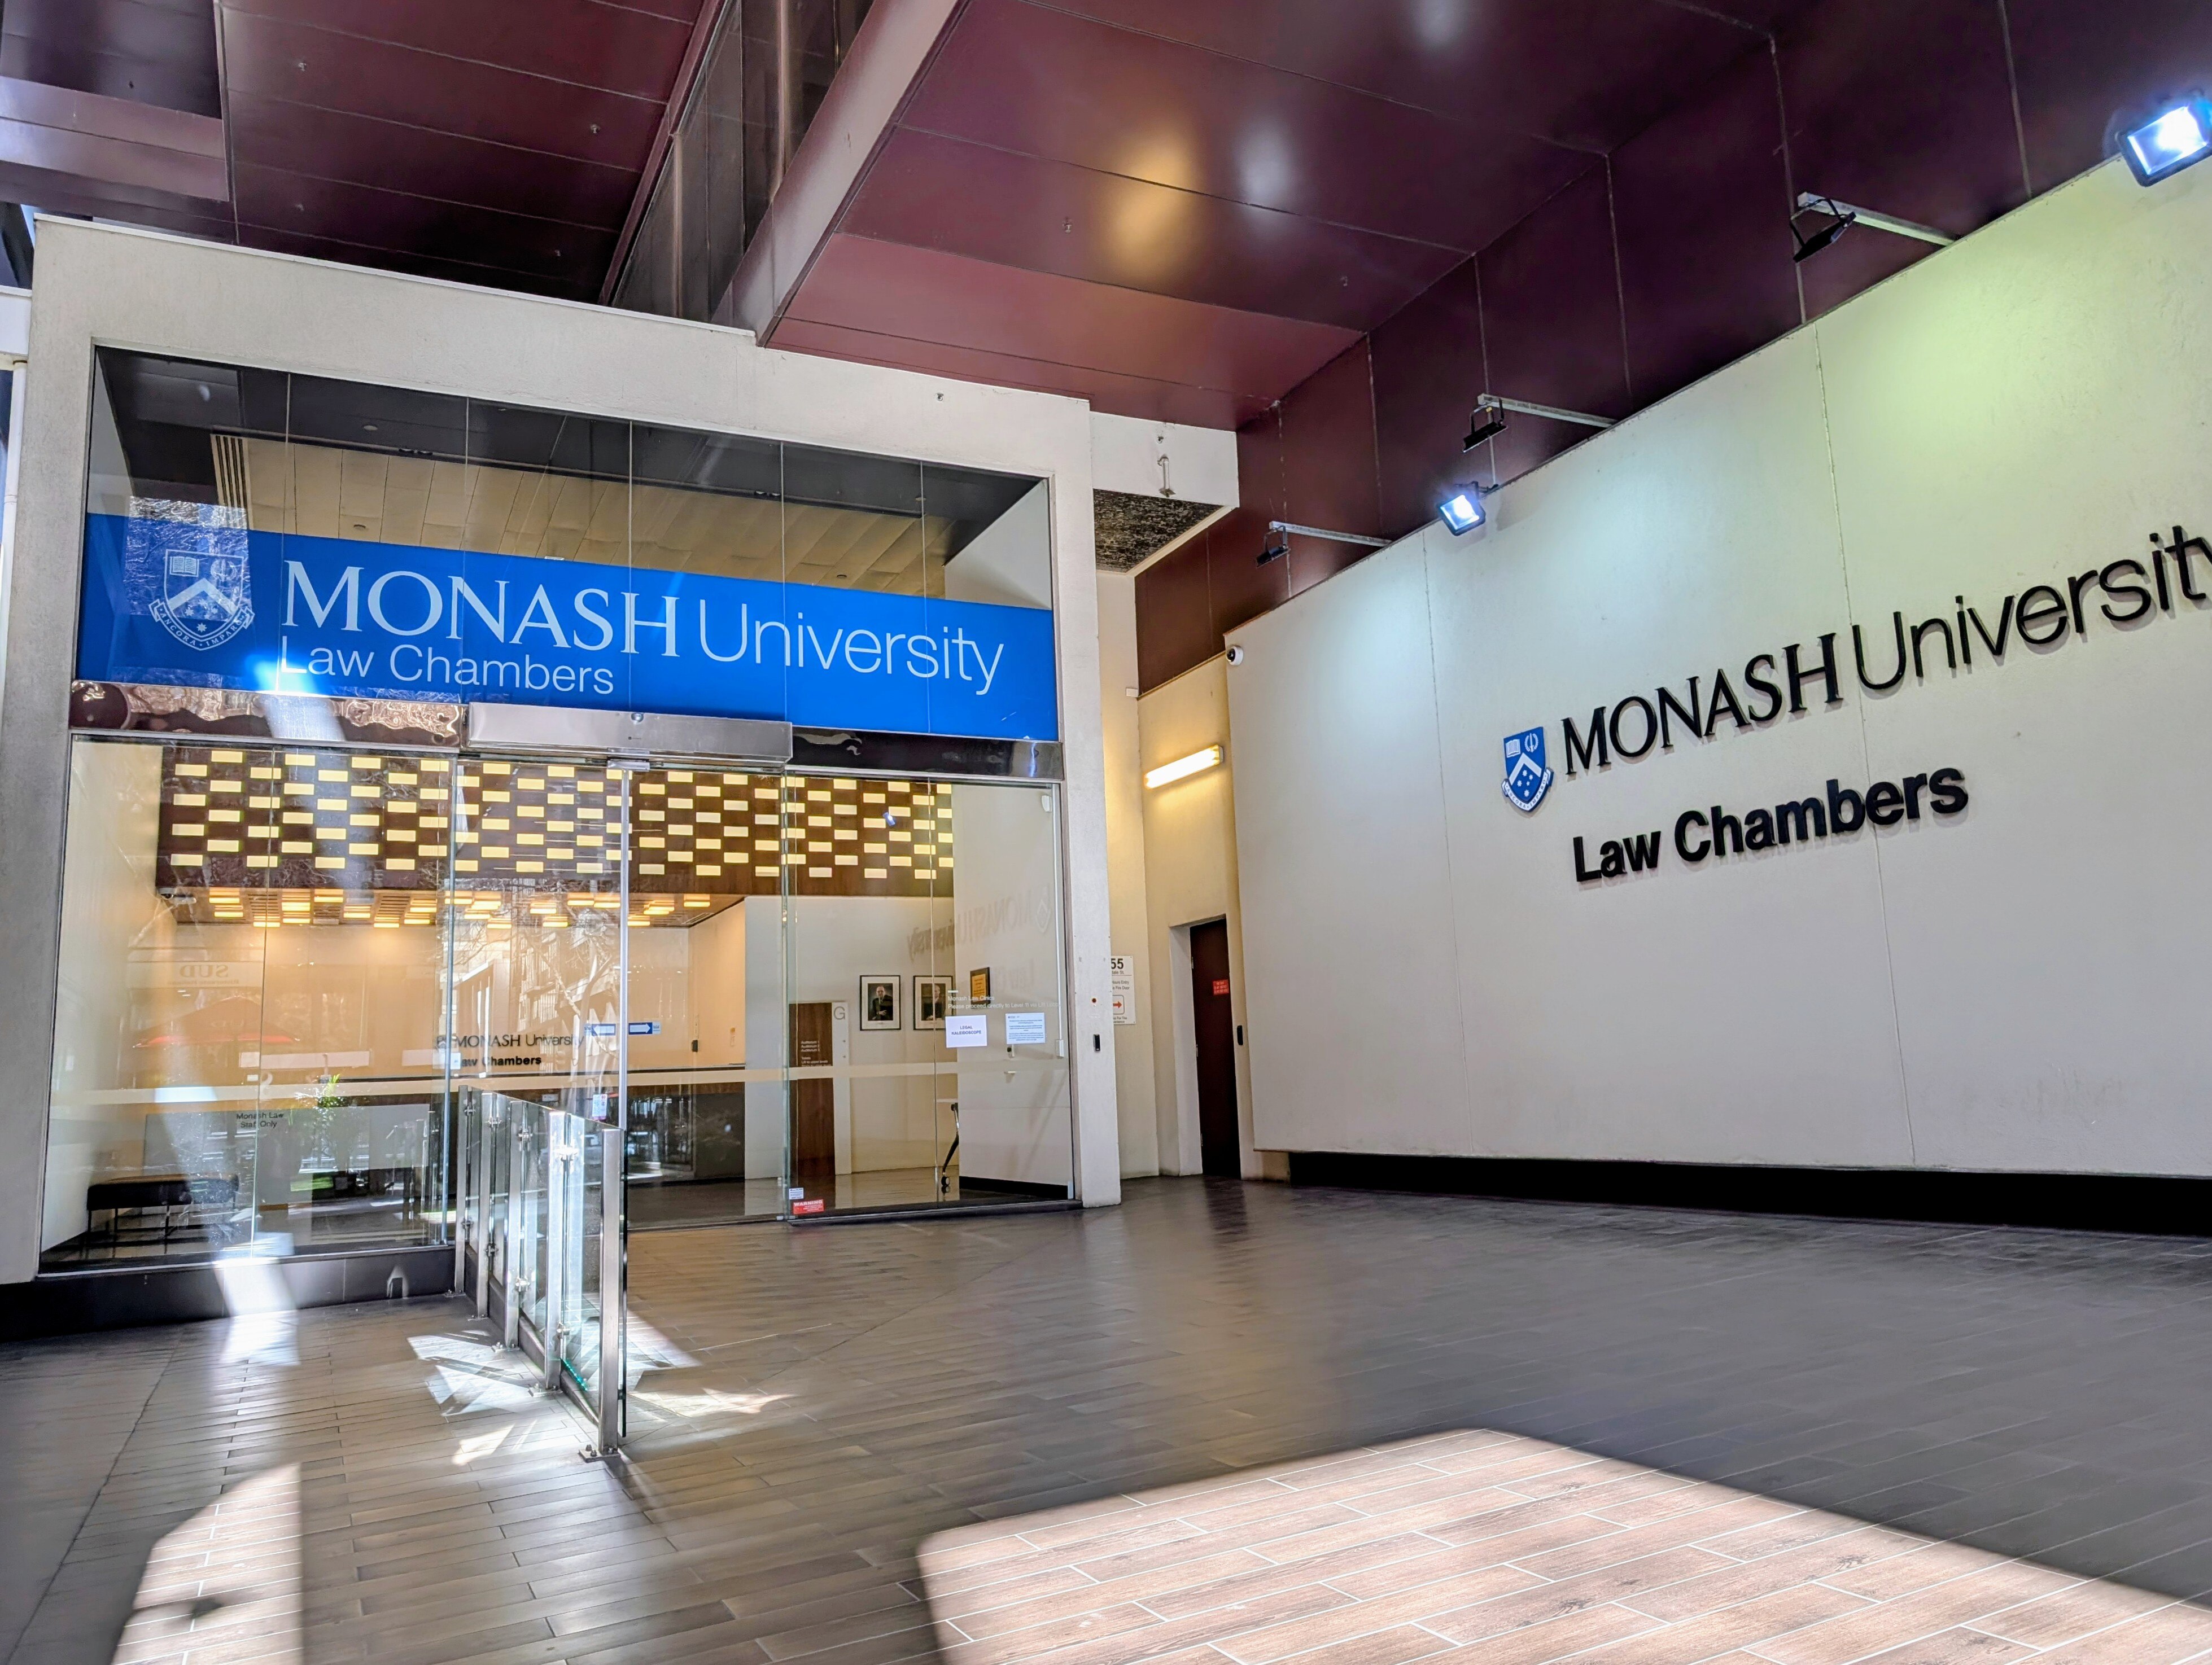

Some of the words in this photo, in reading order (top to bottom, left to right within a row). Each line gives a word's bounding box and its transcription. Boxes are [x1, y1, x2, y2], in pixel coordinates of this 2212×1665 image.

[160, 611, 196, 646] ANCORA
[206, 619, 242, 646] IMPARO
[283, 560, 679, 657] MONASH
[700, 599, 1004, 695] University
[281, 636, 374, 677] Law
[390, 645, 614, 694] Chambers
[1562, 633, 1843, 775] MONASH
[1507, 788, 1526, 808] ANCORA
[1530, 779, 1546, 807] IMPARO
[1573, 831, 1662, 883] Law
[1674, 768, 1969, 862] Chambers
[834, 1006, 846, 1020] G
[461, 1057, 478, 1066] aw
[260, 1120, 277, 1129] Only
